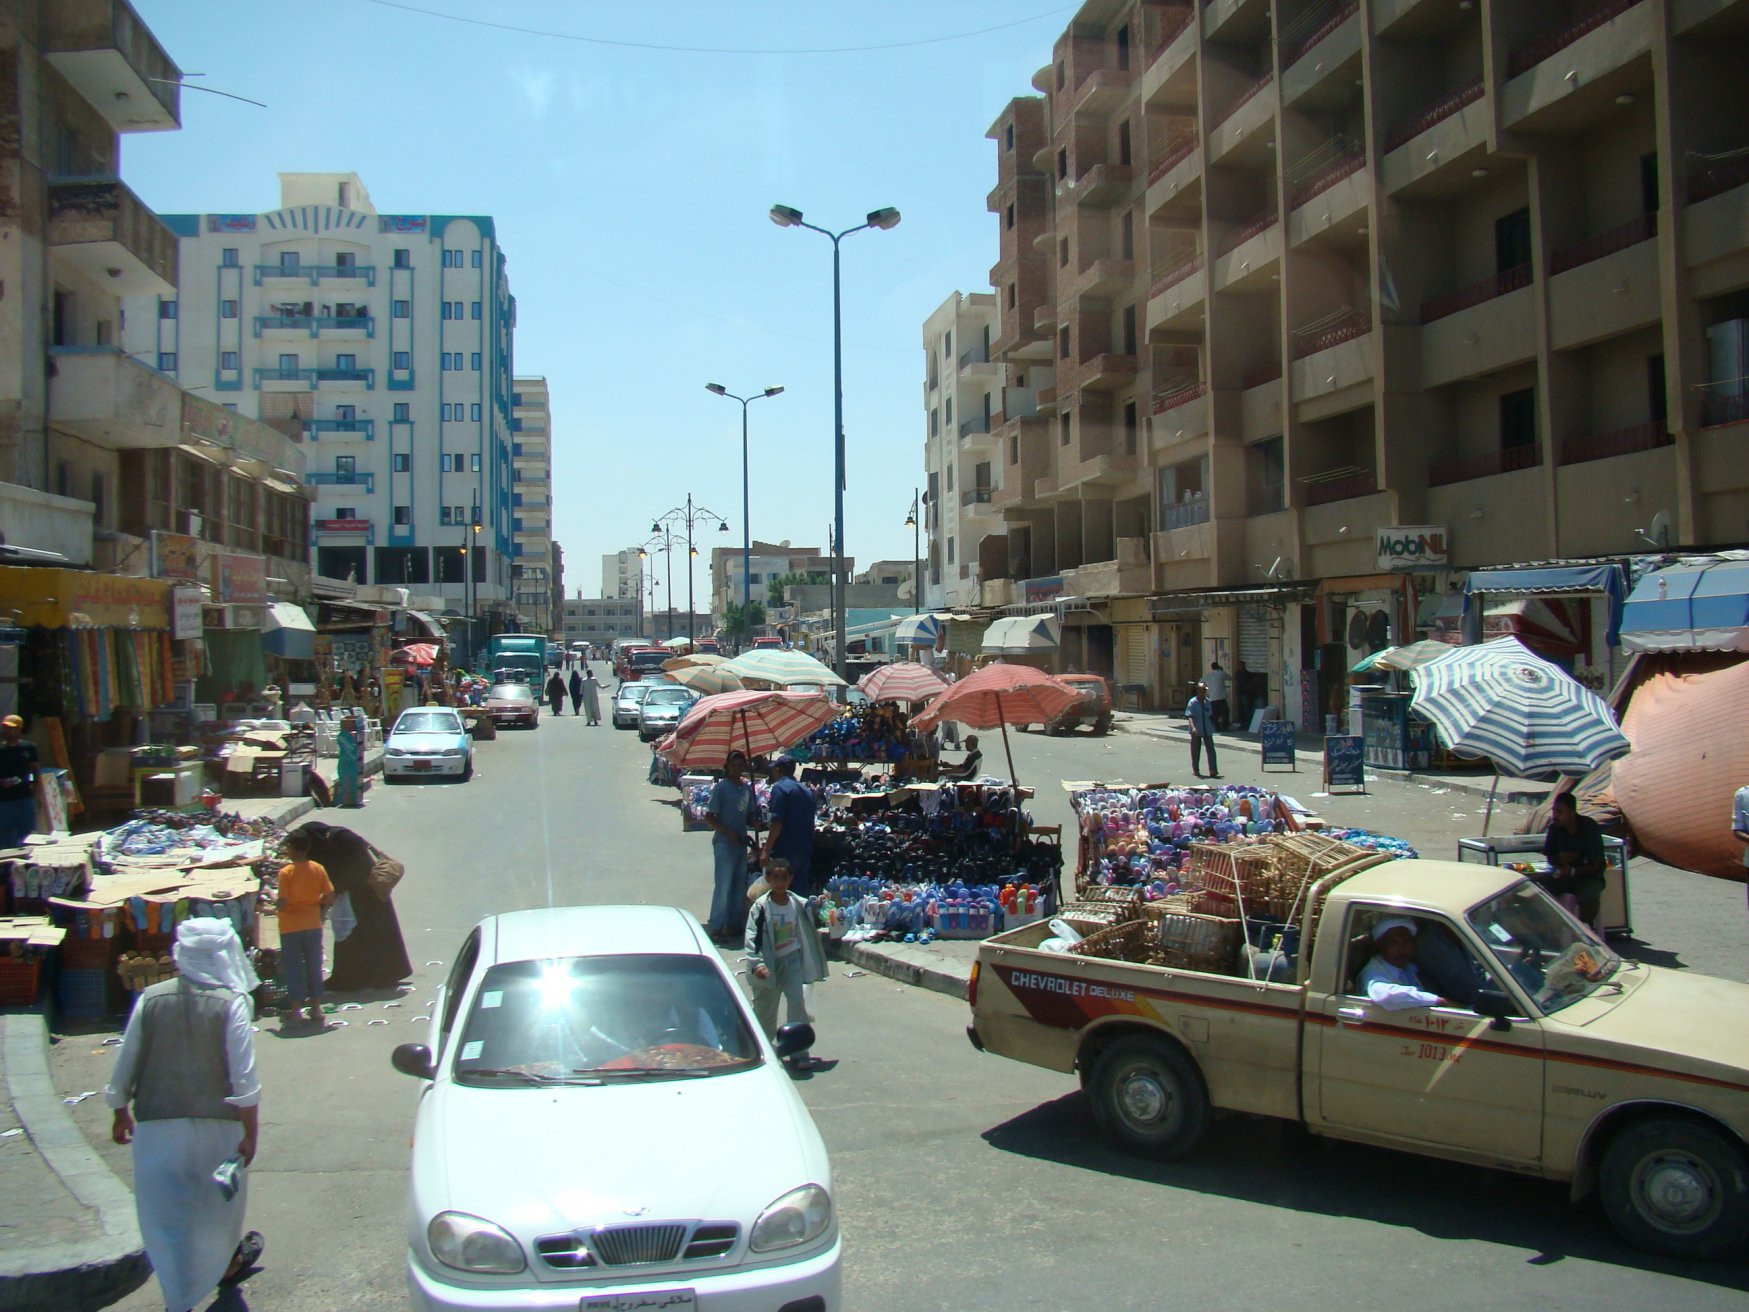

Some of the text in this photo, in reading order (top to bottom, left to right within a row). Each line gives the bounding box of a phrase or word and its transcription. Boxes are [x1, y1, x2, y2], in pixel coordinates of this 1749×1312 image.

[1011, 971, 1135, 1002] CHEVROLET DELUXE
[1418, 1044, 1446, 1061] 1013
